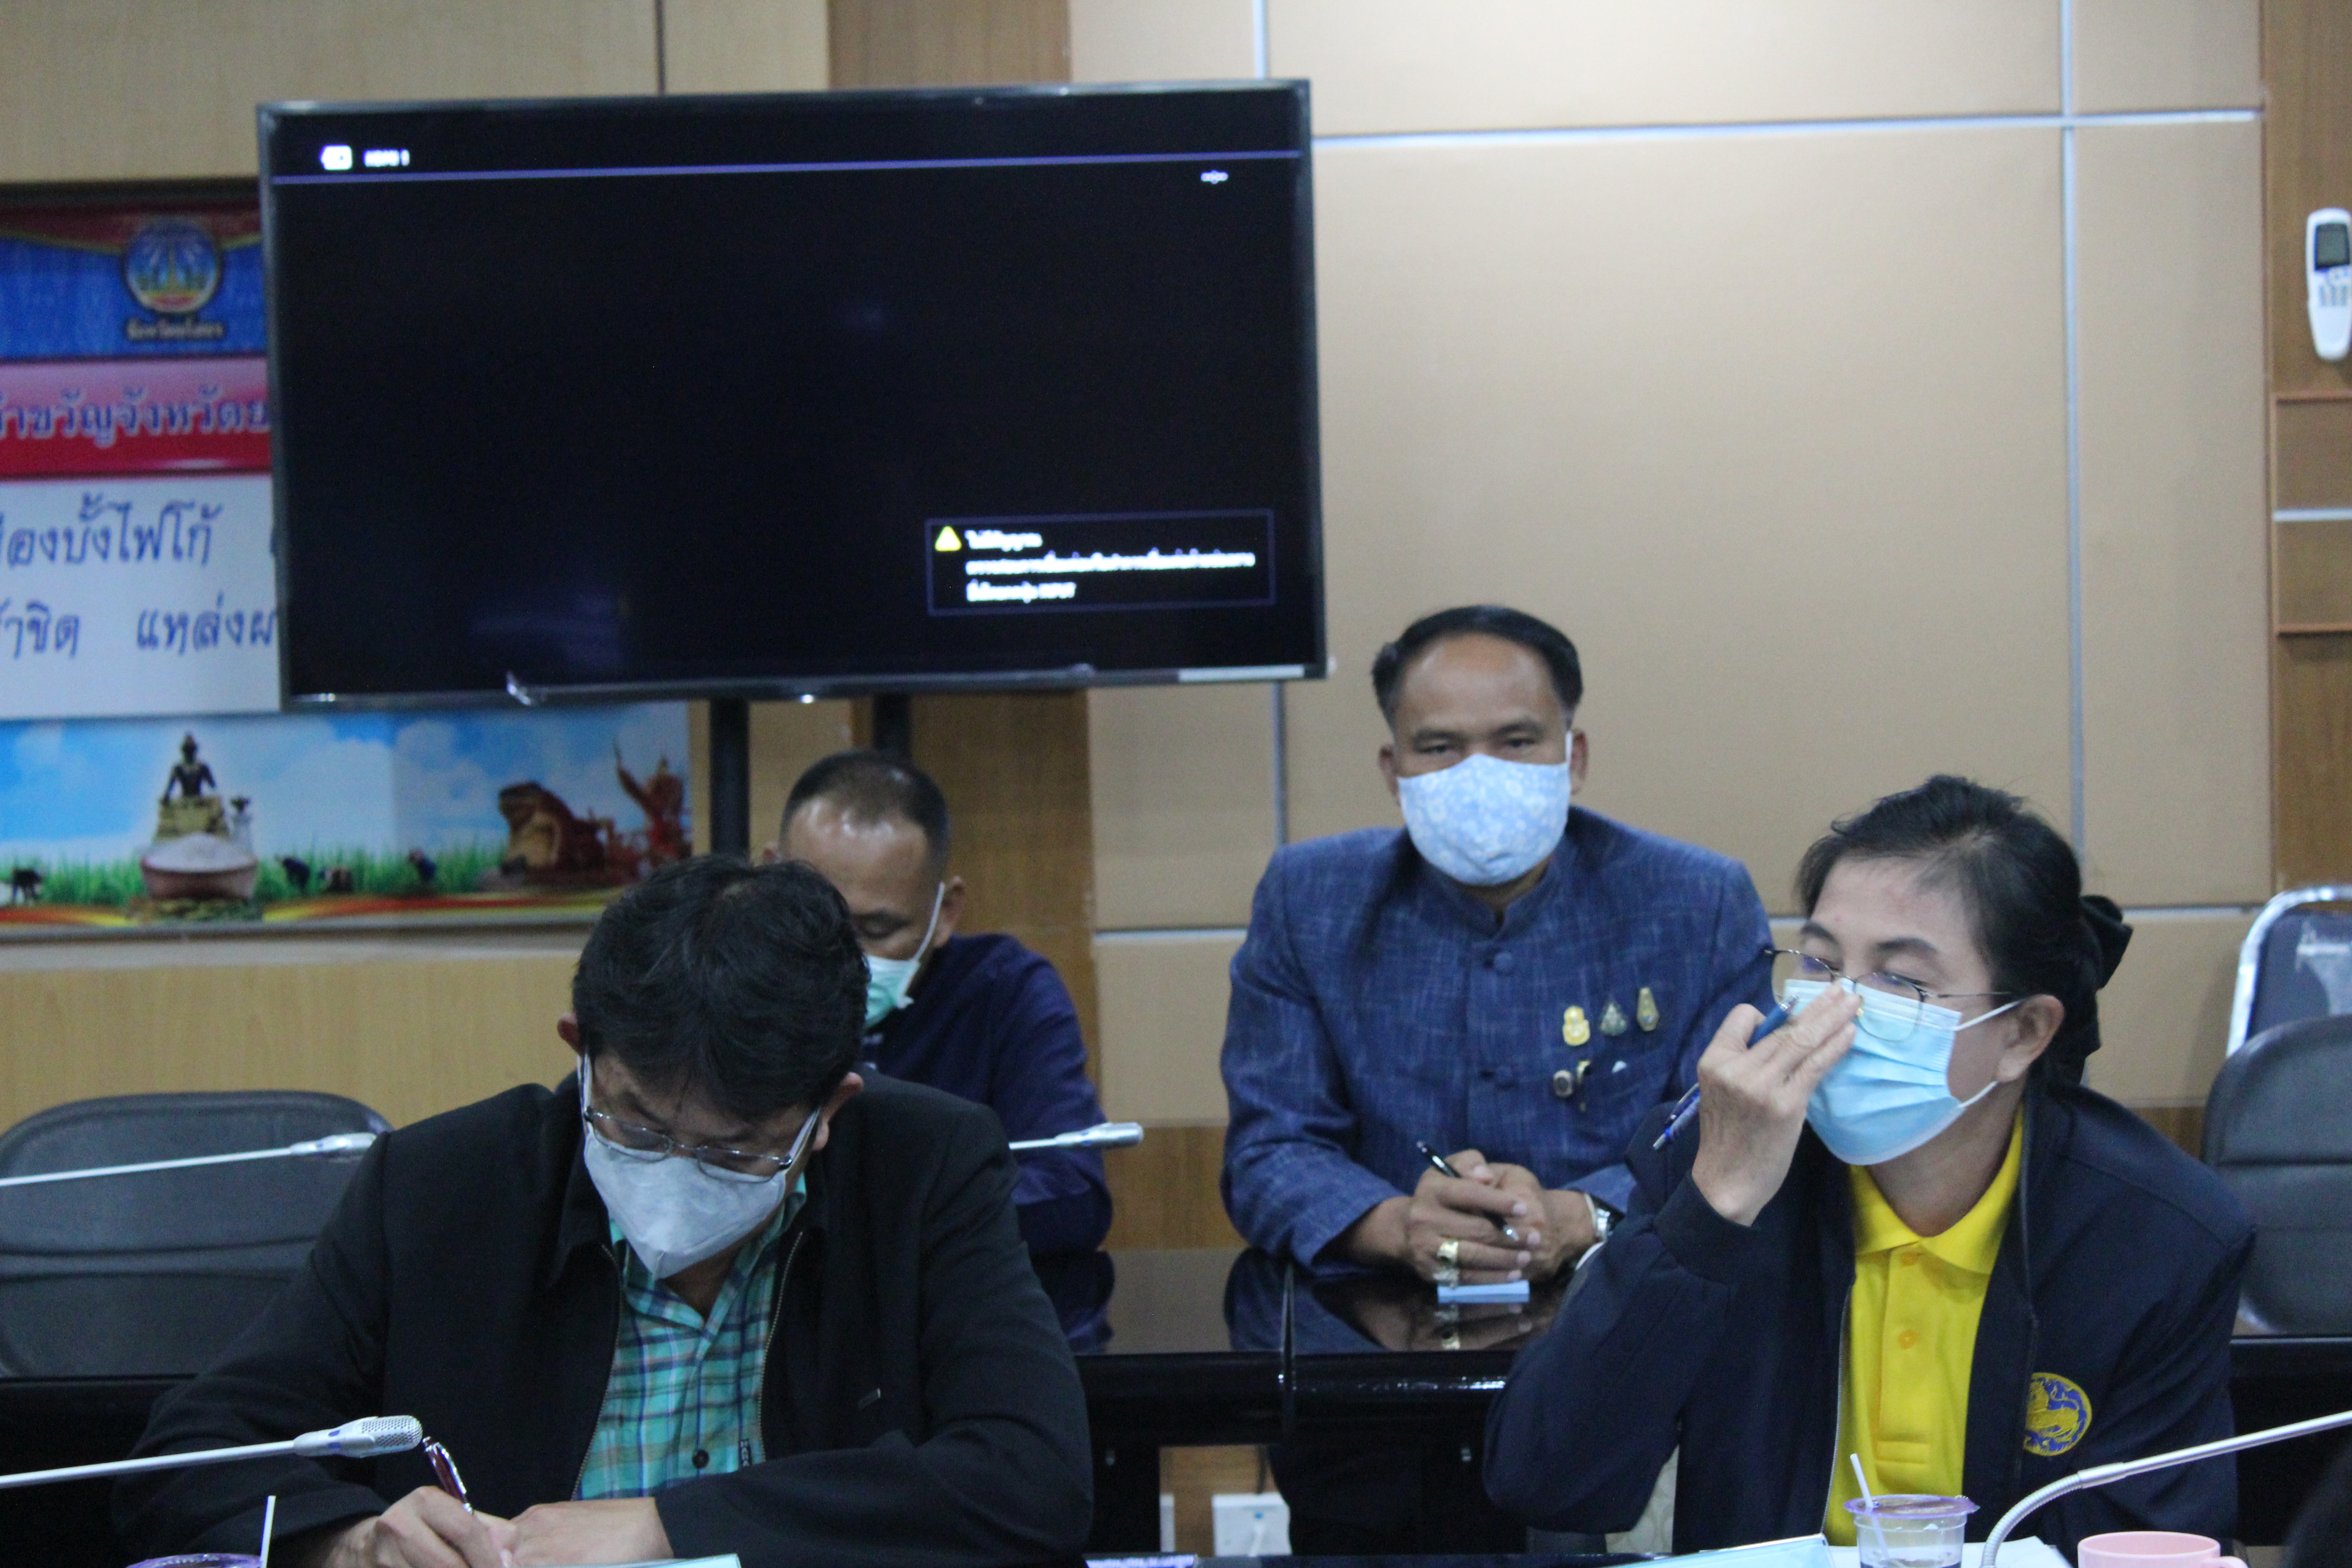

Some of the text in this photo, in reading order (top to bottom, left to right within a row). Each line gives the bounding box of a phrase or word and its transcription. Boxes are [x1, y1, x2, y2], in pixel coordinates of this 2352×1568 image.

[0, 492, 224, 568] องบั้งไฟโก้
